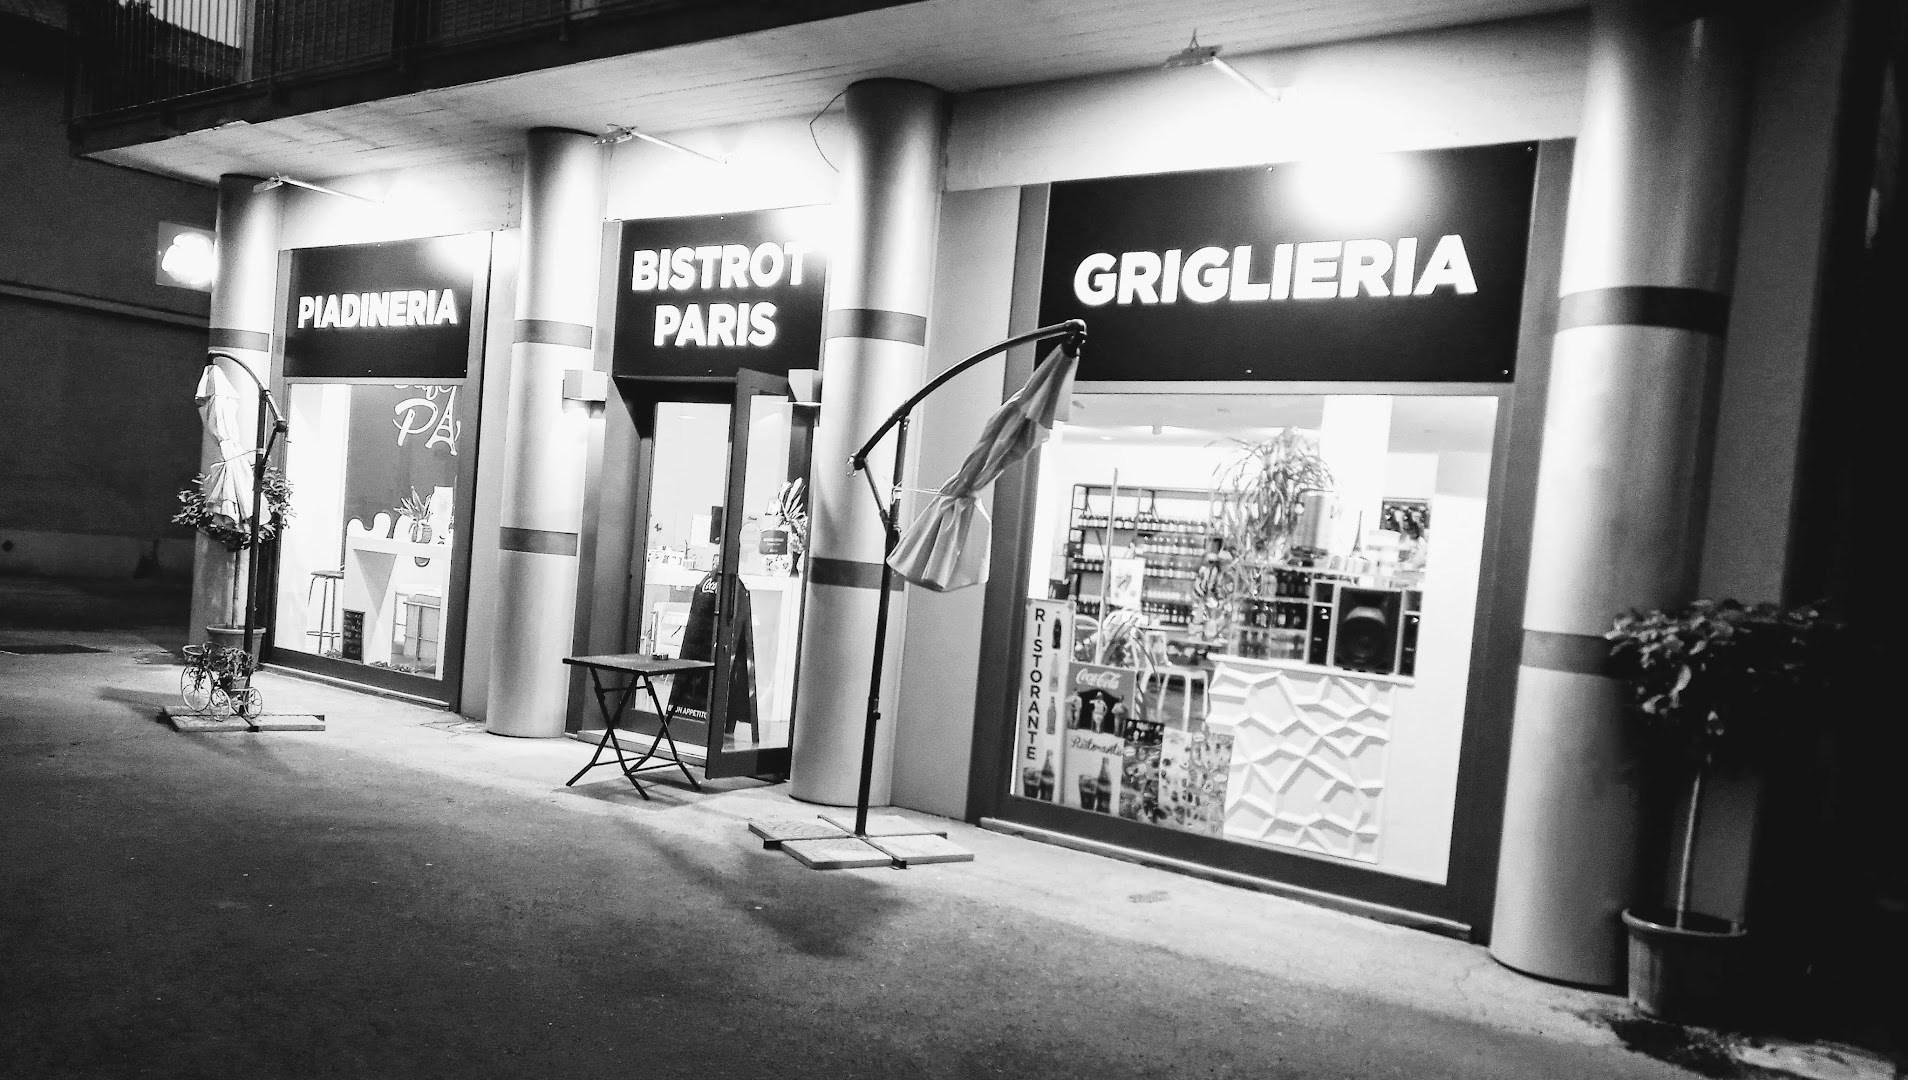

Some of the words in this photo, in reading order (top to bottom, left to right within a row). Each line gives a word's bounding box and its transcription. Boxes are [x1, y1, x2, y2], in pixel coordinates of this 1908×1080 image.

[631, 240, 807, 292] BISTROT
[1073, 233, 1478, 307] GRIGLIERIA
[297, 288, 458, 329] PIADINERIA
[653, 301, 778, 347] PARIS
[1026, 607, 1046, 761] RISTORANTE
